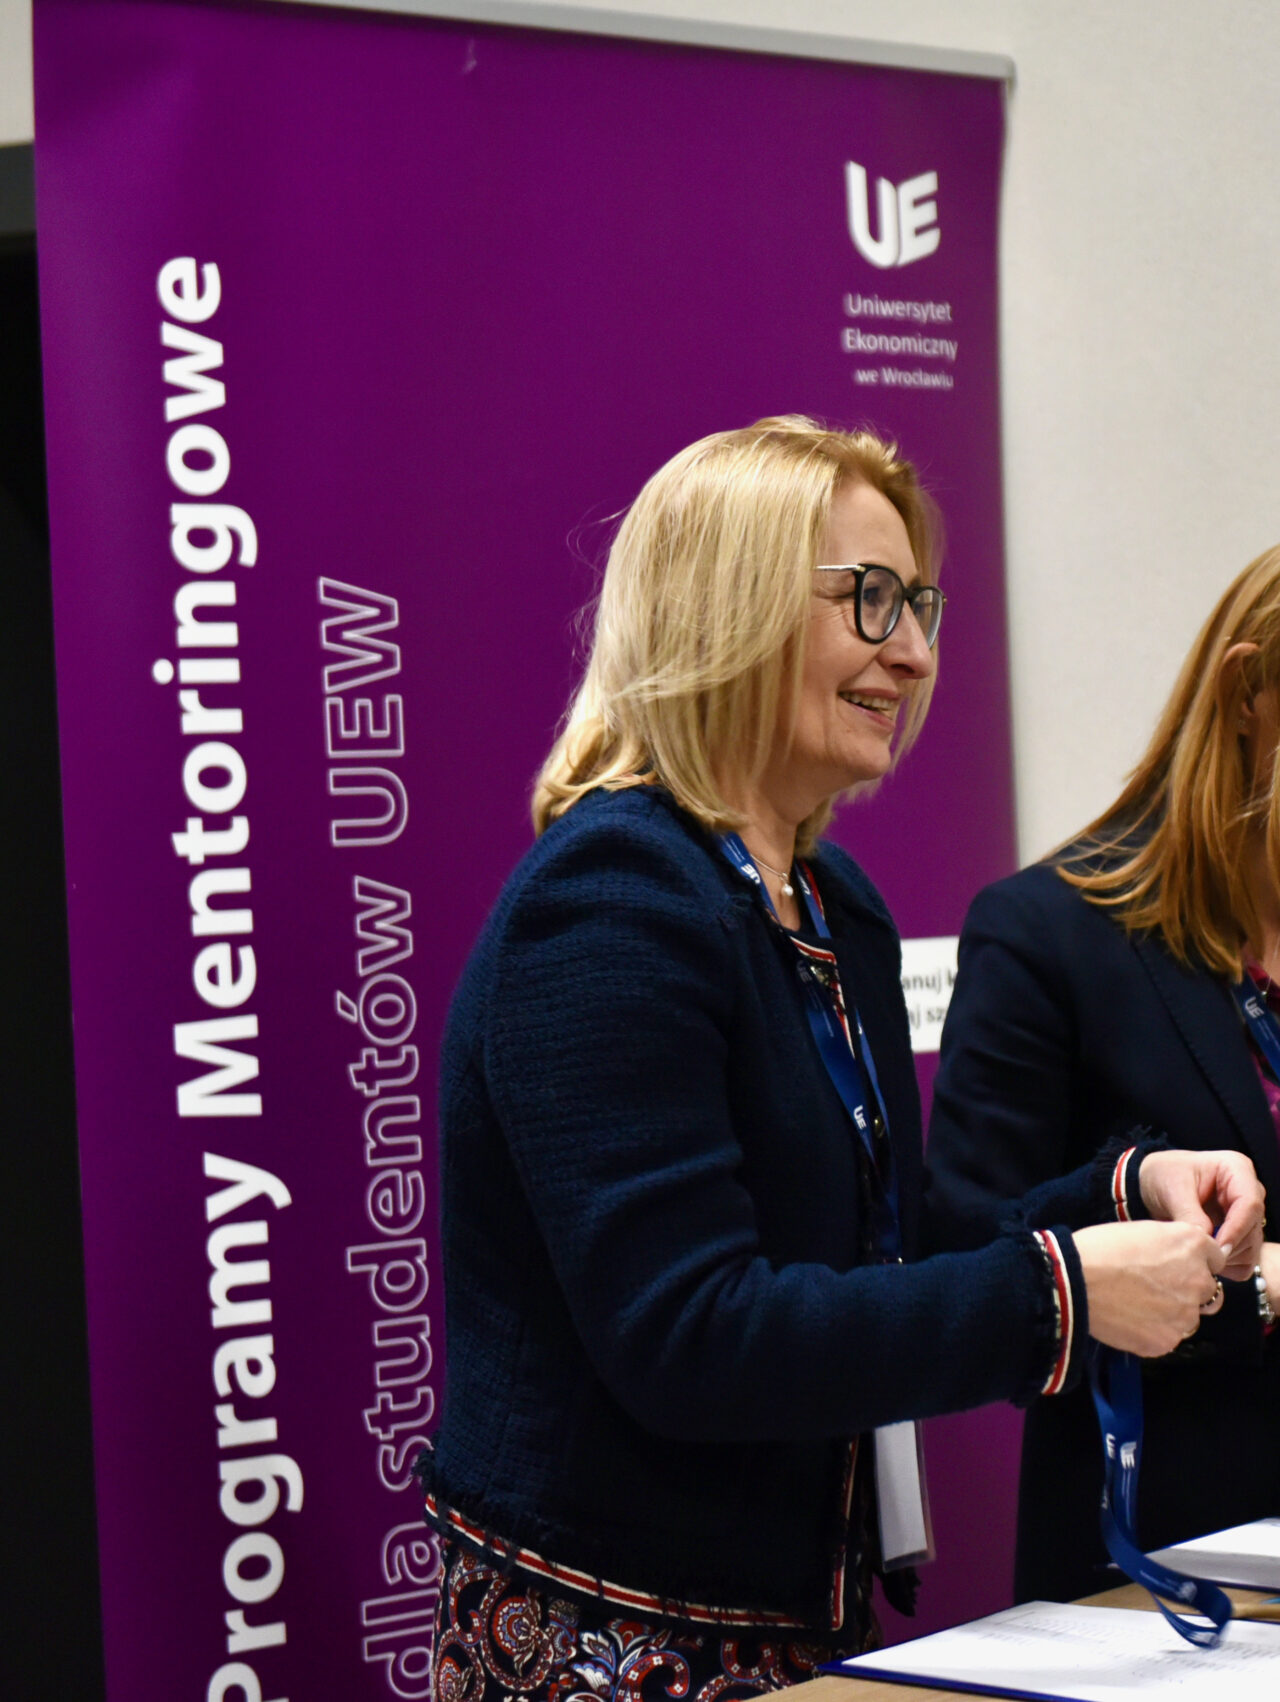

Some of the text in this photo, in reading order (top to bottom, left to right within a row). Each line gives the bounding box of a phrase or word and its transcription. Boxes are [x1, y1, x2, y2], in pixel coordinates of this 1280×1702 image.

[846, 161, 941, 269] UE
[846, 293, 952, 323] Uniwersytet
[842, 328, 958, 361] Ekonomiczny
[856, 369, 880, 384] we
[153, 255, 305, 1702] Programy Mentoringowe
[902, 968, 942, 994] anuj
[1244, 996, 1265, 1019] UE
[853, 1104, 867, 1130] UE
[318, 576, 441, 1700] dla studentów UEW
